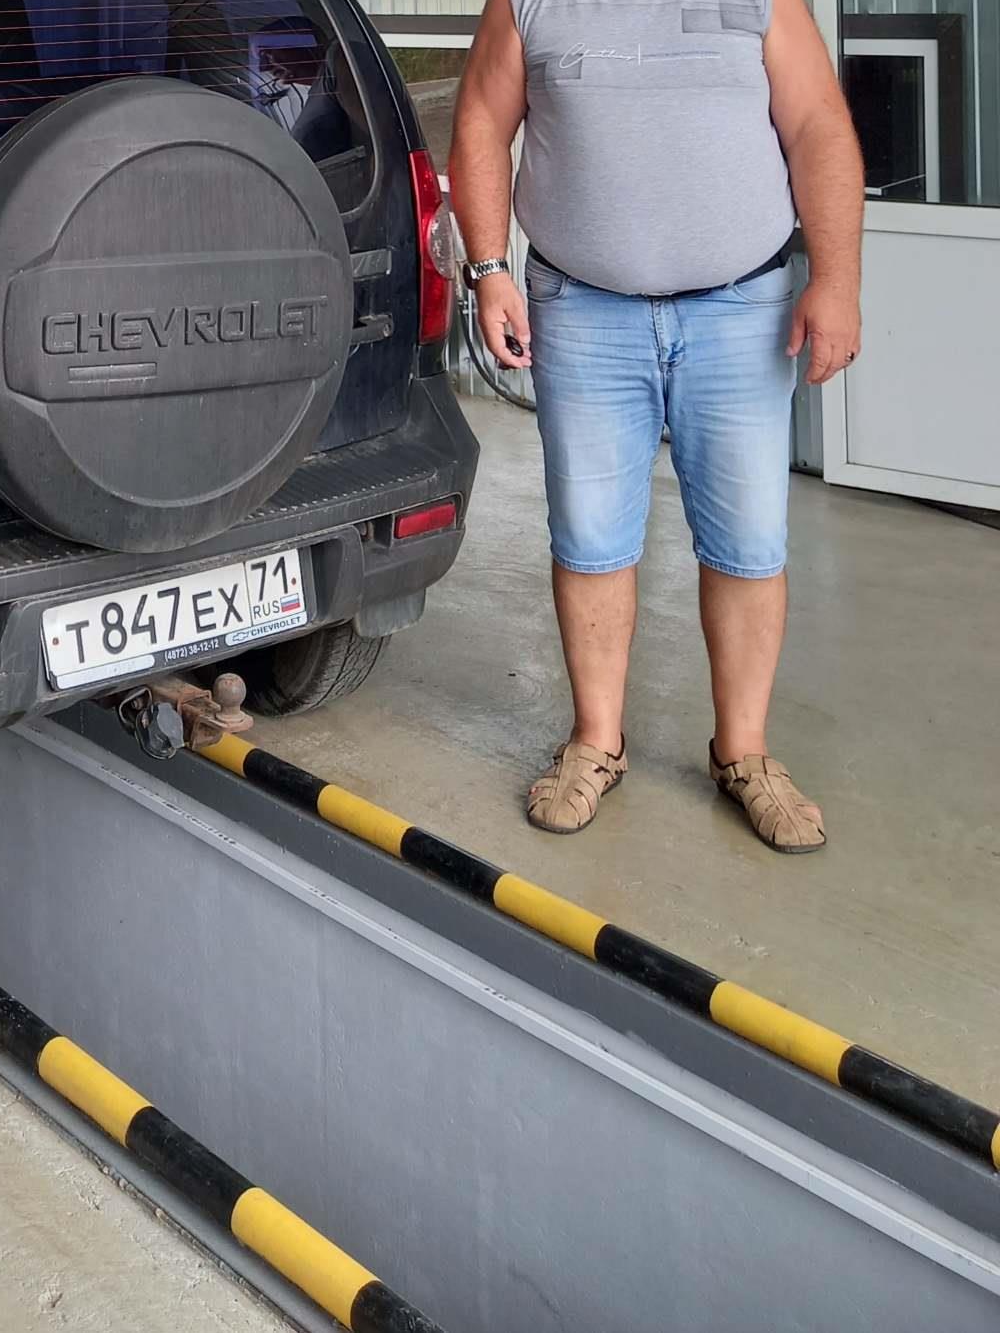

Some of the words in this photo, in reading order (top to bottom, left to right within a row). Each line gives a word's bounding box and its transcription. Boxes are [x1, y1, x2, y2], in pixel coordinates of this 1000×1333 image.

[42, 295, 328, 355] CHEVROLET
[250, 556, 289, 601] 71
[251, 616, 301, 636] CHEVROLET
[252, 601, 280, 619] RUS
